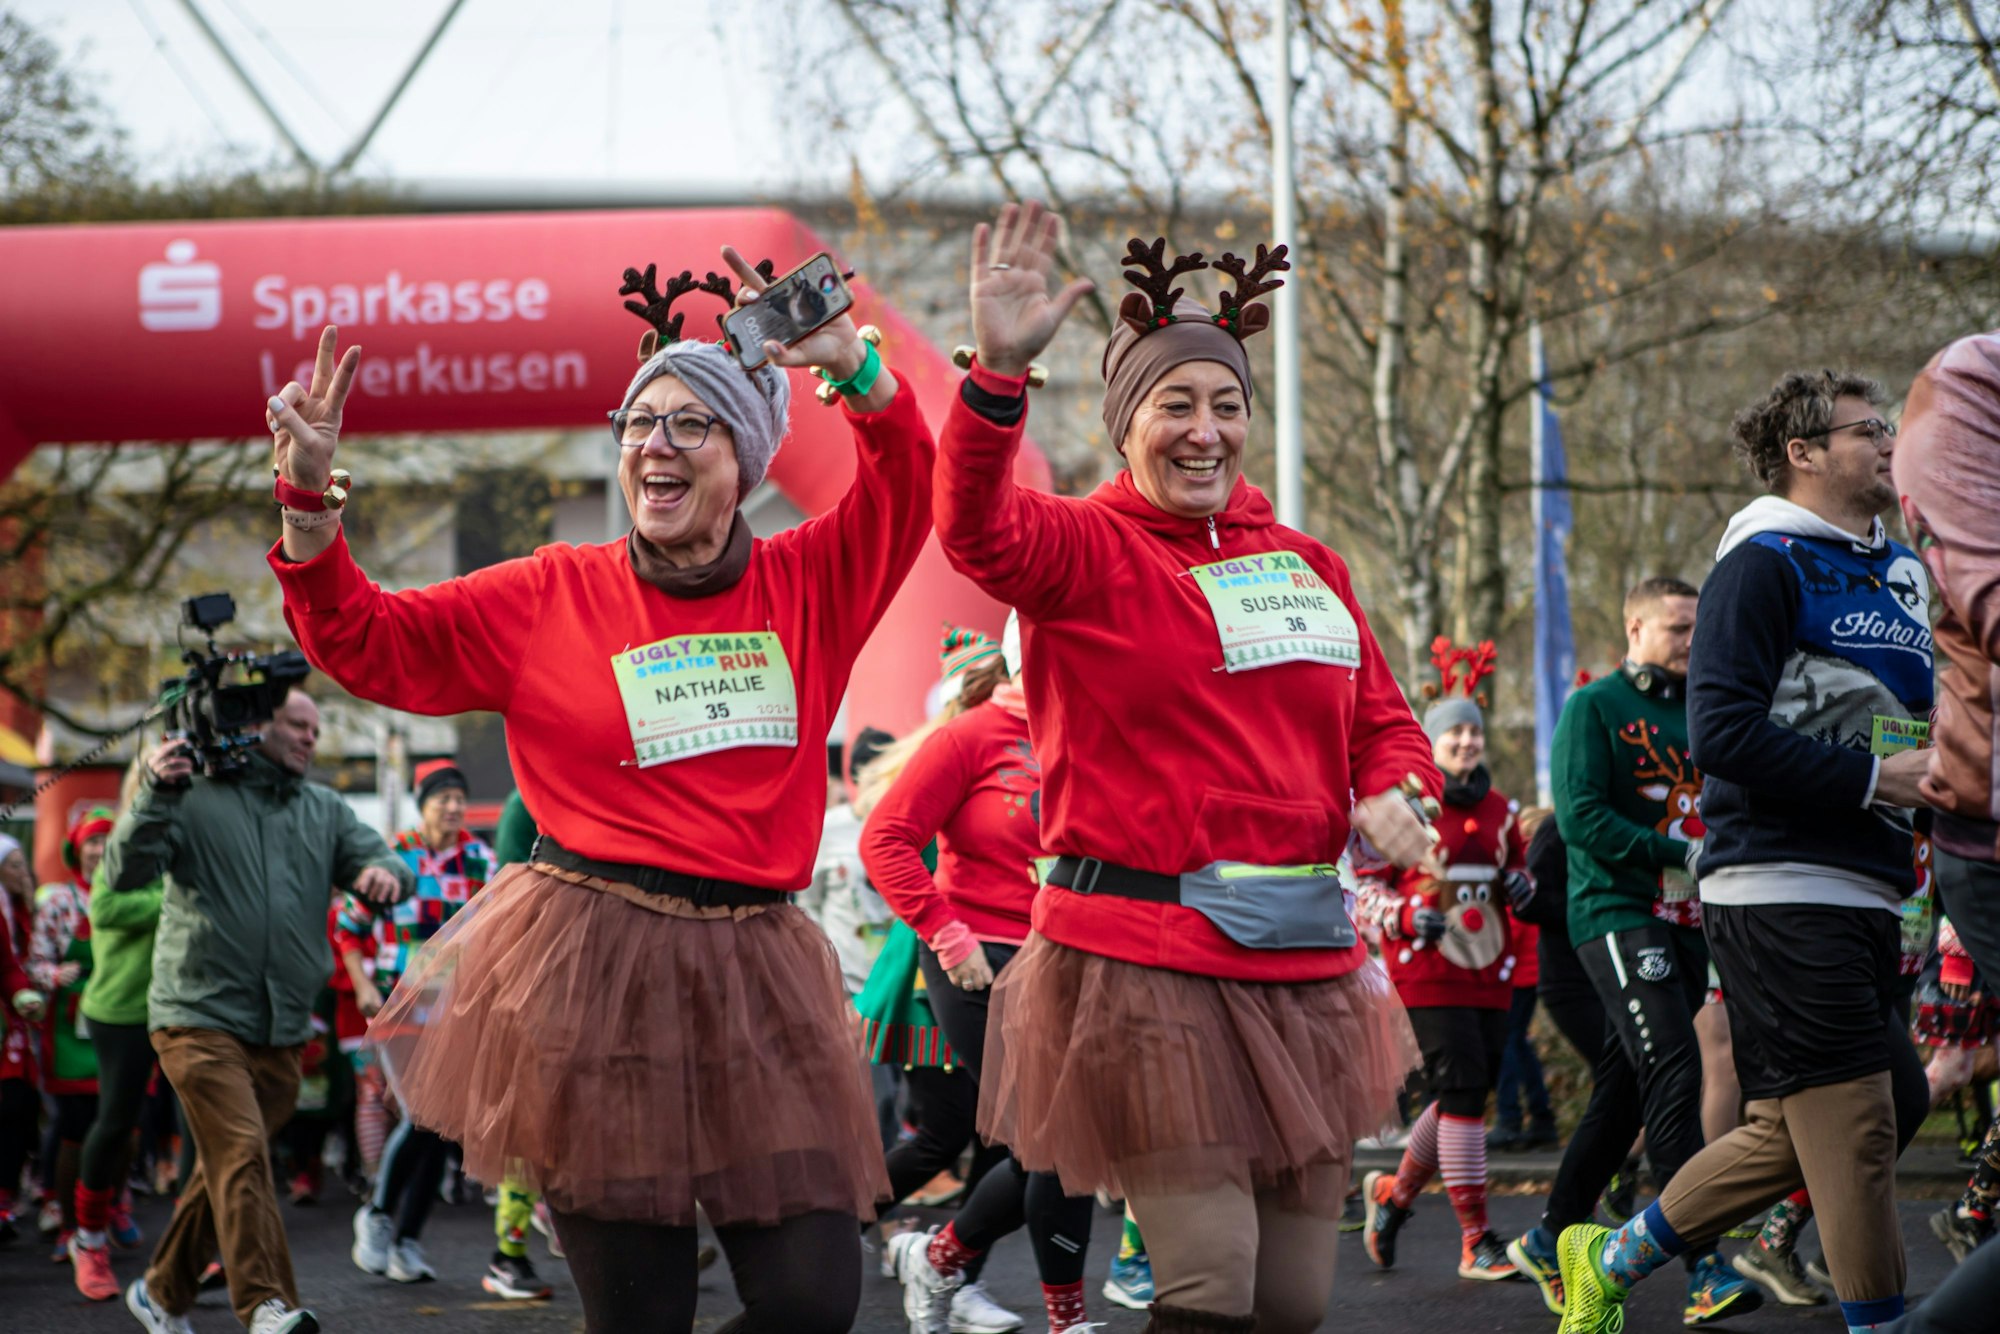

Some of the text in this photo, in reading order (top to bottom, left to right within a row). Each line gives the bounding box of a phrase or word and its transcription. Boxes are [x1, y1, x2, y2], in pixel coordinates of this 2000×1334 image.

[253, 270, 550, 340] Sparkasse
[259, 342, 588, 400] Leerkusen
[1208, 558, 1264, 577] UGLY
[1217, 572, 1289, 590] SWEATER
[1240, 594, 1328, 614] SUSANNE
[1284, 616, 1307, 632] 36
[629, 637, 763, 666] UGLY XMAS
[635, 651, 769, 679] SWEATER RUN
[655, 675, 765, 704] NATHALIE
[705, 701, 731, 720] 35
[1882, 719, 1910, 735] UGLY
